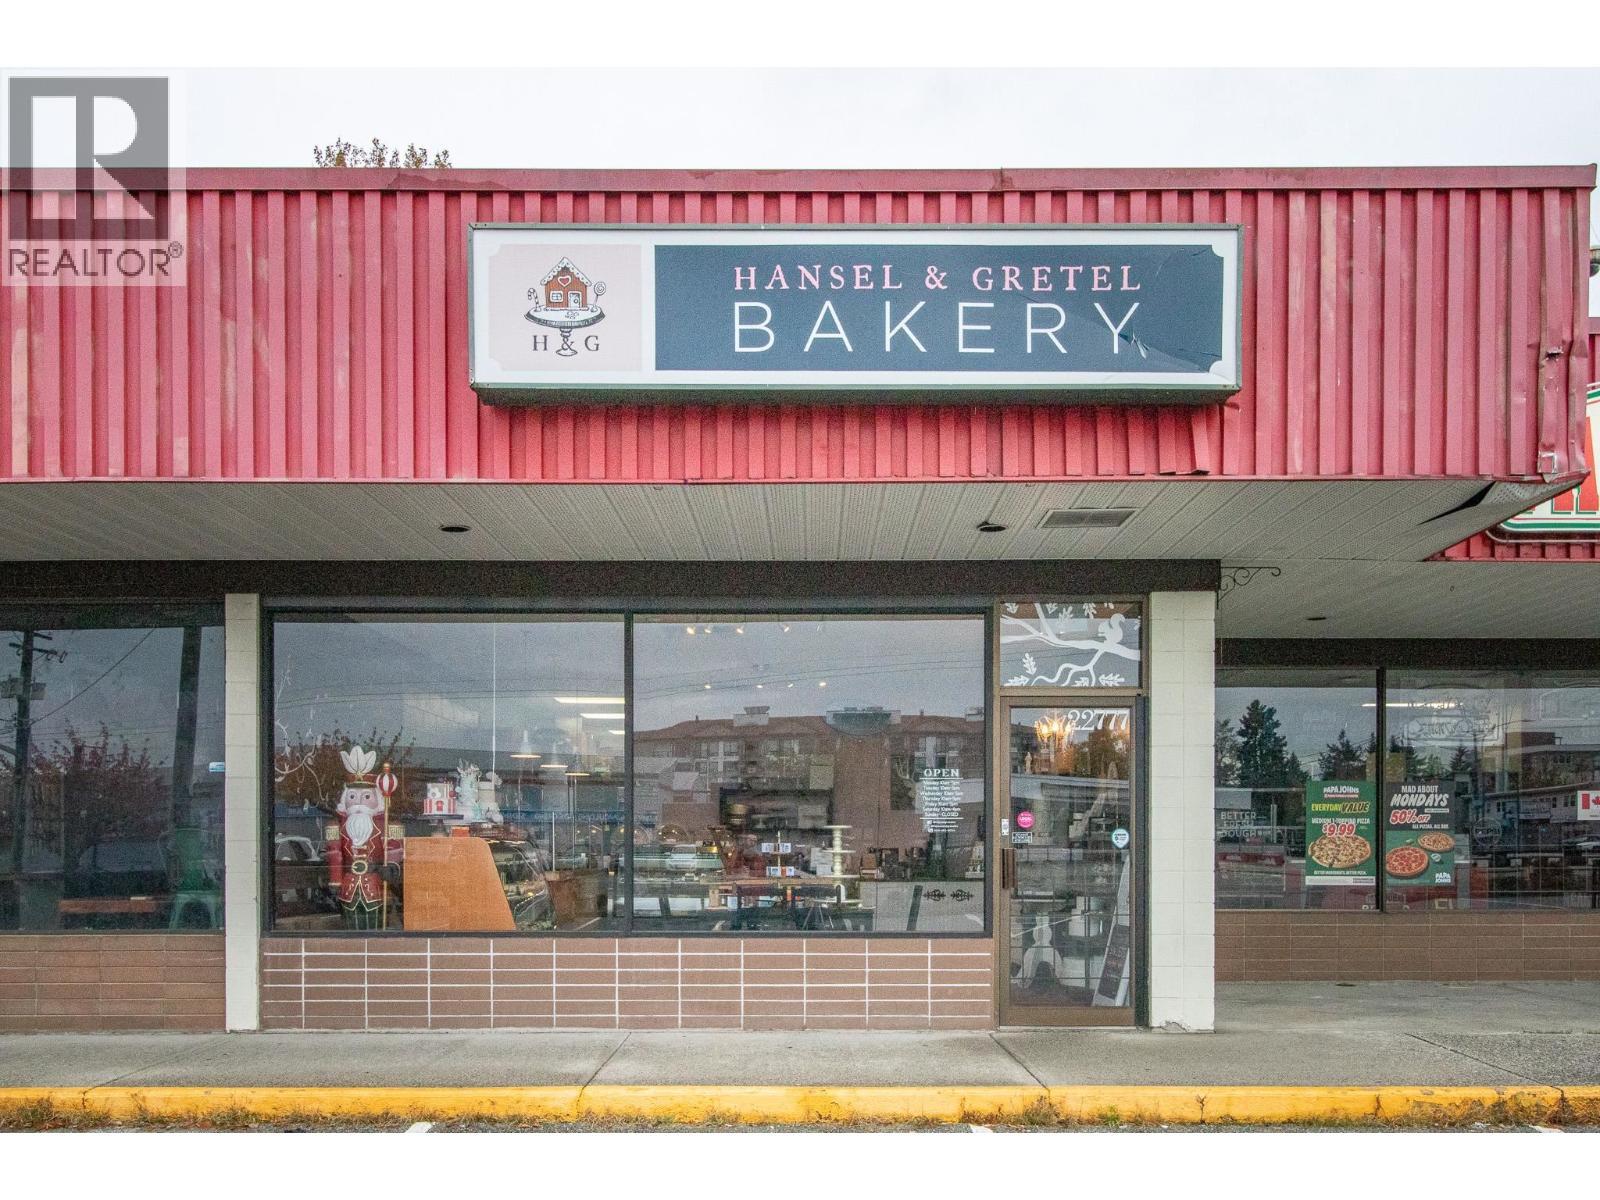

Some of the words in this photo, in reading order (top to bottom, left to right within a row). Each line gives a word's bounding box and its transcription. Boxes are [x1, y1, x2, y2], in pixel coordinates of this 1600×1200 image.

[733, 264, 902, 290] HANSEL
[925, 265, 948, 289] &
[972, 265, 1141, 291] GRETEL
[734, 300, 1141, 354] BAKERY
[532, 335, 548, 351] H
[584, 335, 600, 351] G
[1067, 709, 1130, 730] 22777
[924, 768, 960, 777] OPEN
[1323, 785, 1339, 793] PAPA
[1339, 785, 1360, 793] JOHNS
[1401, 785, 1417, 793] MAD
[1417, 785, 1439, 793] ABOUT
[1390, 794, 1449, 807] MONDAYS
[1311, 803, 1341, 812] EVERYDAY
[1341, 802, 1370, 813] VALUE
[1221, 811, 1257, 820] BETTER
[1390, 809, 1417, 824] 50%
[1417, 814, 1431, 823] OFF
[1220, 829, 1257, 838] DOUGH
[1322, 823, 1356, 837] $9.99
